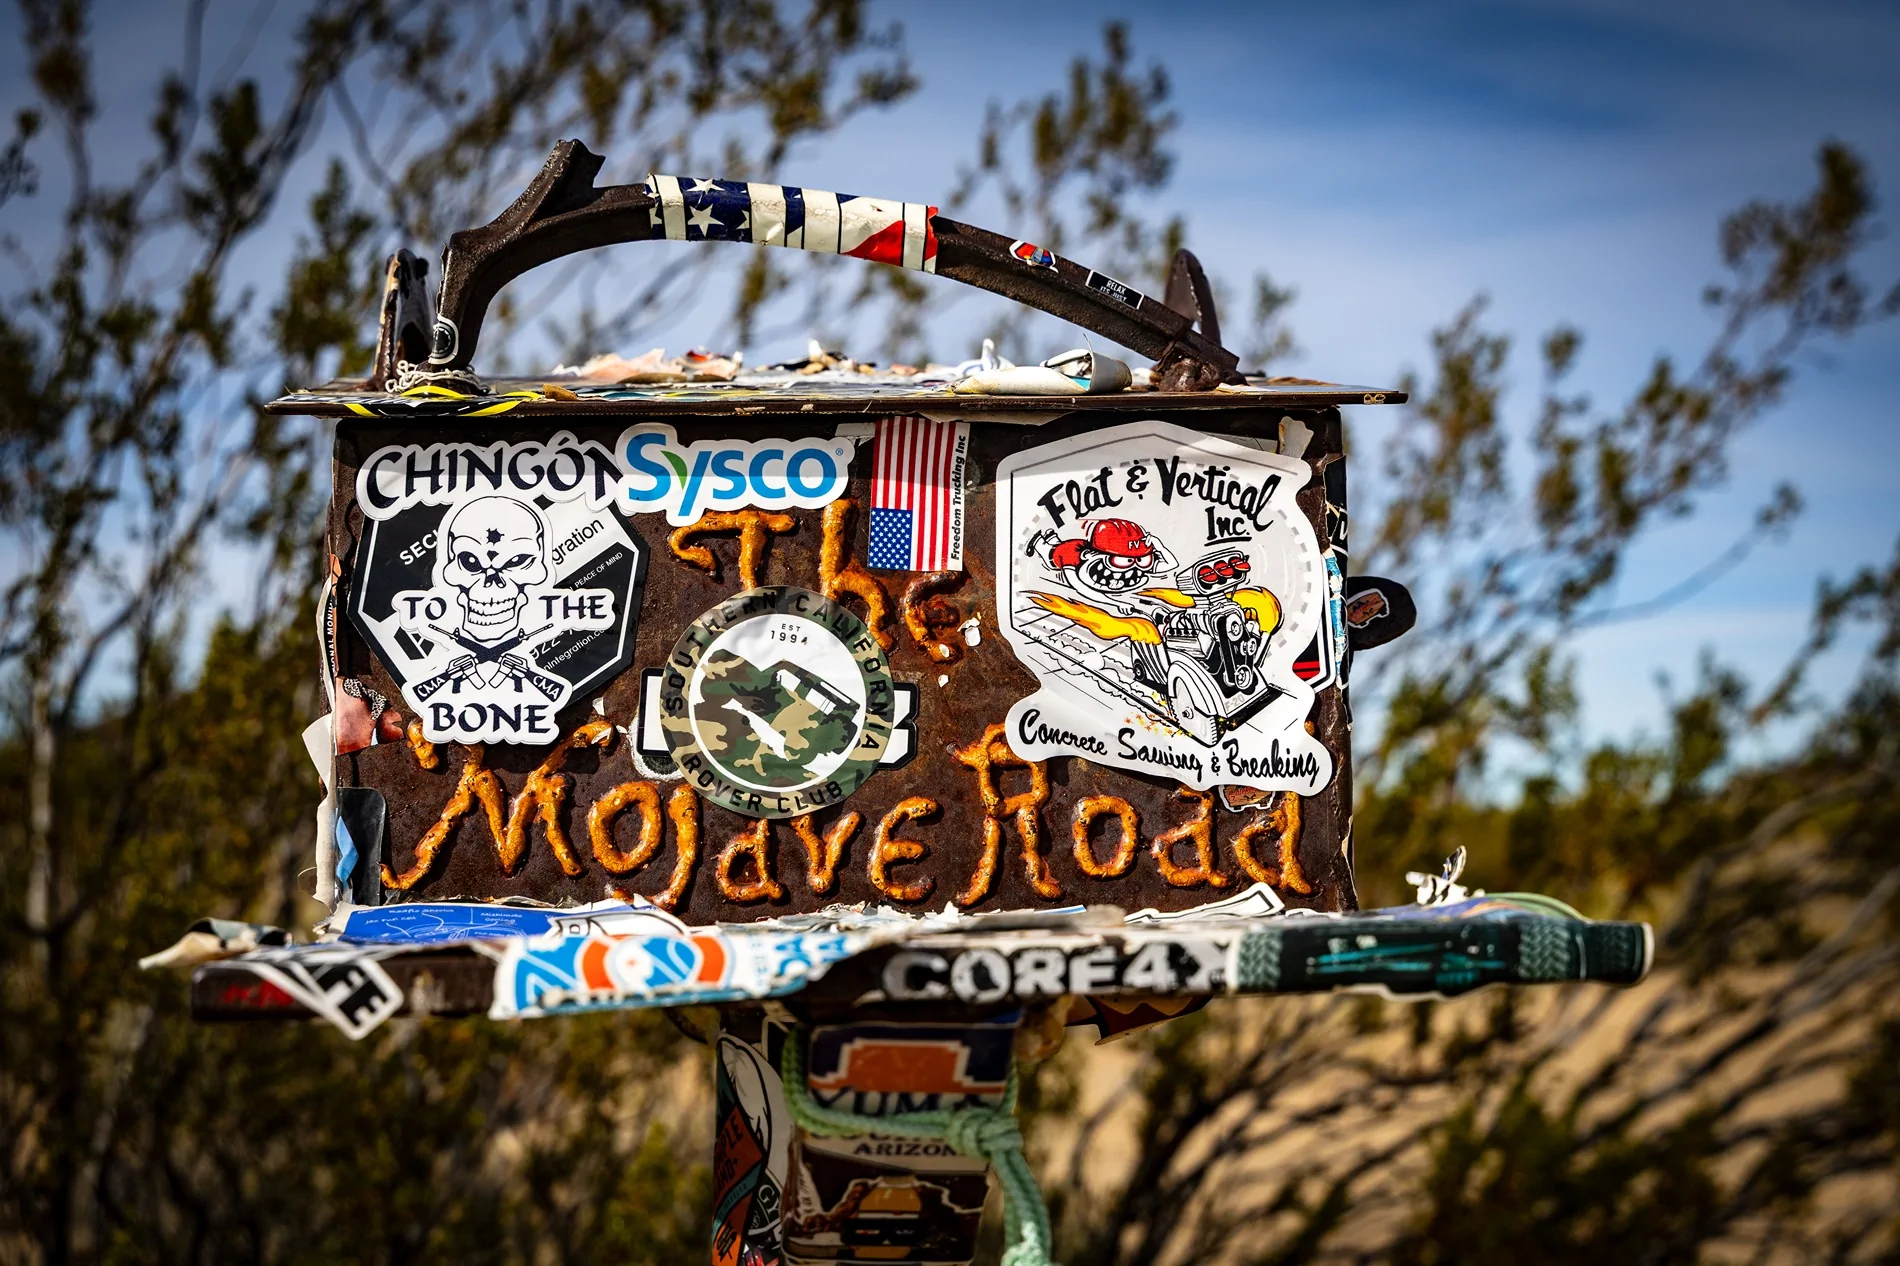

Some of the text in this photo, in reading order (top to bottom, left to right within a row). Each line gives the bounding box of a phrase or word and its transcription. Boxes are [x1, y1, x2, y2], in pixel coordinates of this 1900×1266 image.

[1106, 280, 1127, 295] RELAX
[951, 434, 966, 560] Freedom Trucking Inc
[1037, 455, 1282, 532] Flat & Vertical
[1204, 506, 1250, 541] Inc.
[399, 530, 437, 566] SEC
[1128, 540, 1141, 550] FV
[574, 569, 598, 589] PEACE
[596, 563, 605, 573] OF
[605, 552, 624, 566] MIND
[402, 594, 608, 621] TO THE
[771, 630, 808, 645] 1994
[781, 623, 801, 632] EST
[417, 676, 446, 697] CMA
[532, 675, 561, 699] CMA
[666, 592, 777, 711] SOUTHERN
[795, 594, 888, 751] CALIFORNIA
[428, 703, 552, 734] BONE
[1018, 708, 1320, 788] Concrete Sawing & Breaking
[682, 754, 843, 813] ROVER CLUB
[853, 1142, 958, 1157] ARIZON
